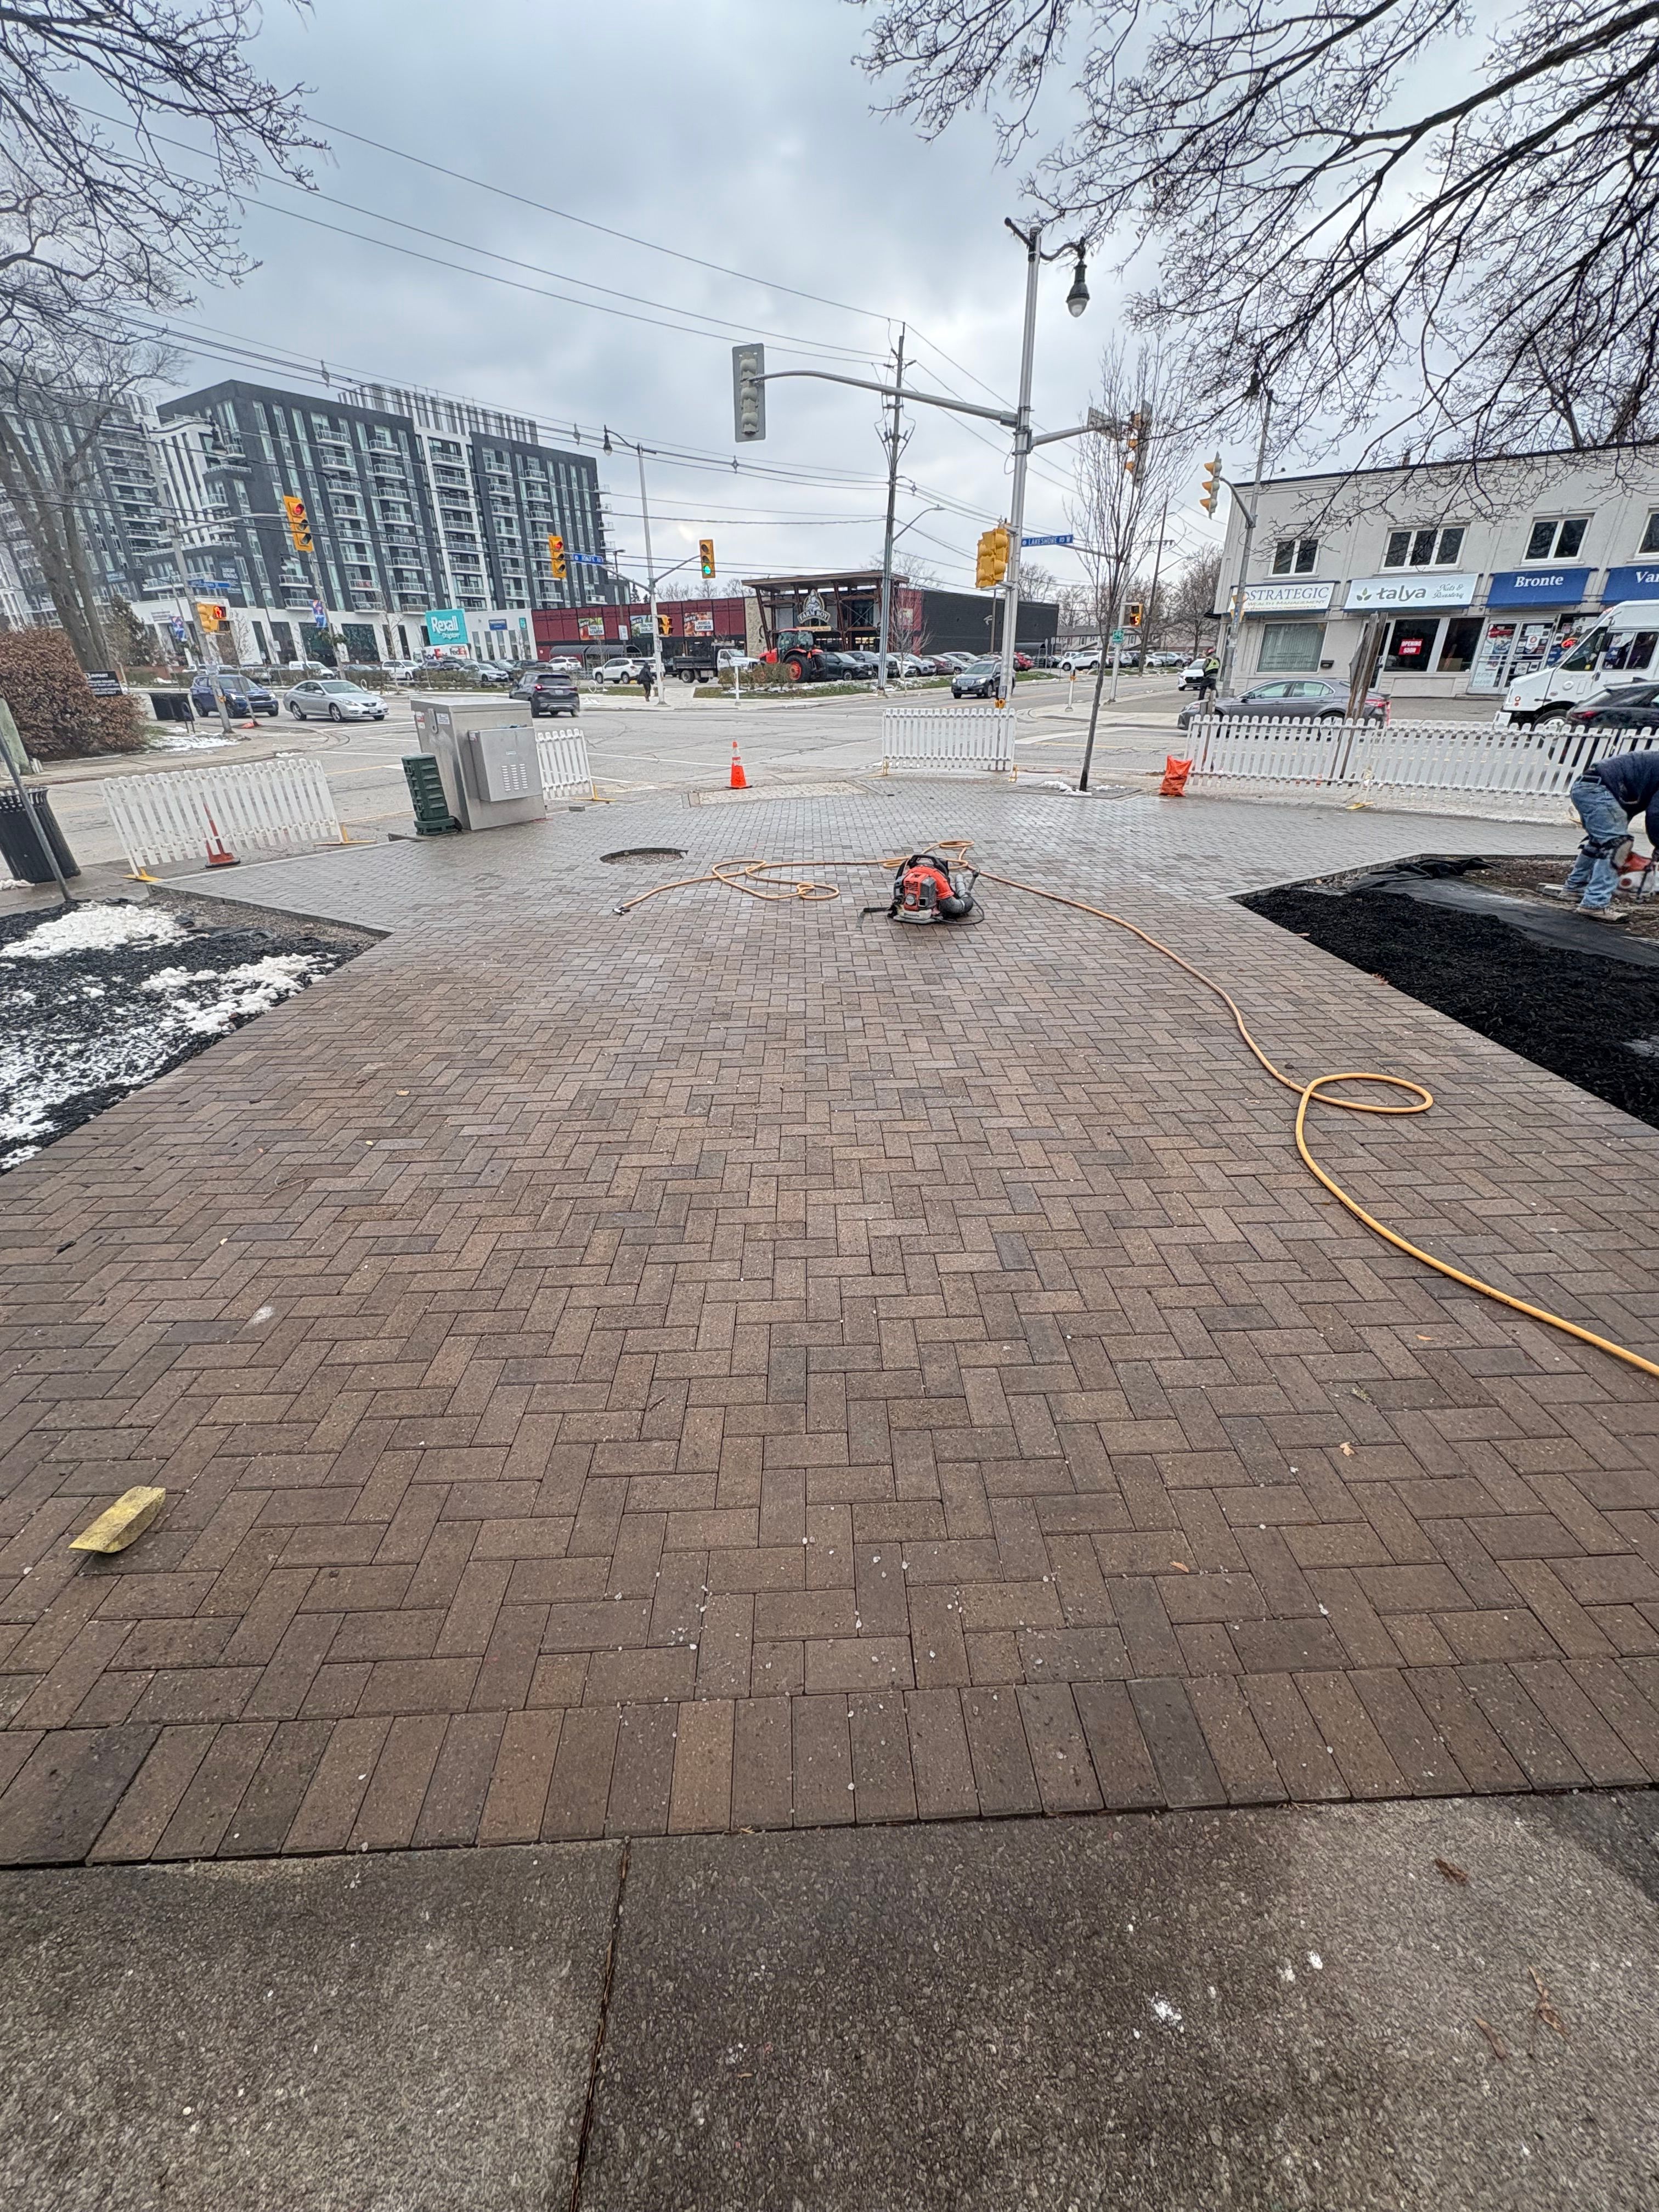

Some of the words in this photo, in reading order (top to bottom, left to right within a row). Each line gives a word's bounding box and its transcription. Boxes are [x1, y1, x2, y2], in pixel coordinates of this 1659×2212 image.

[1028, 537, 1058, 545] LAKESHORE
[1436, 583, 1455, 591] Nuts
[1514, 575, 1564, 588] Bronte
[1376, 585, 1426, 601] talya
[799, 609, 815, 620] FARM
[816, 610, 828, 619] BOY
[431, 616, 459, 633] Rexall
